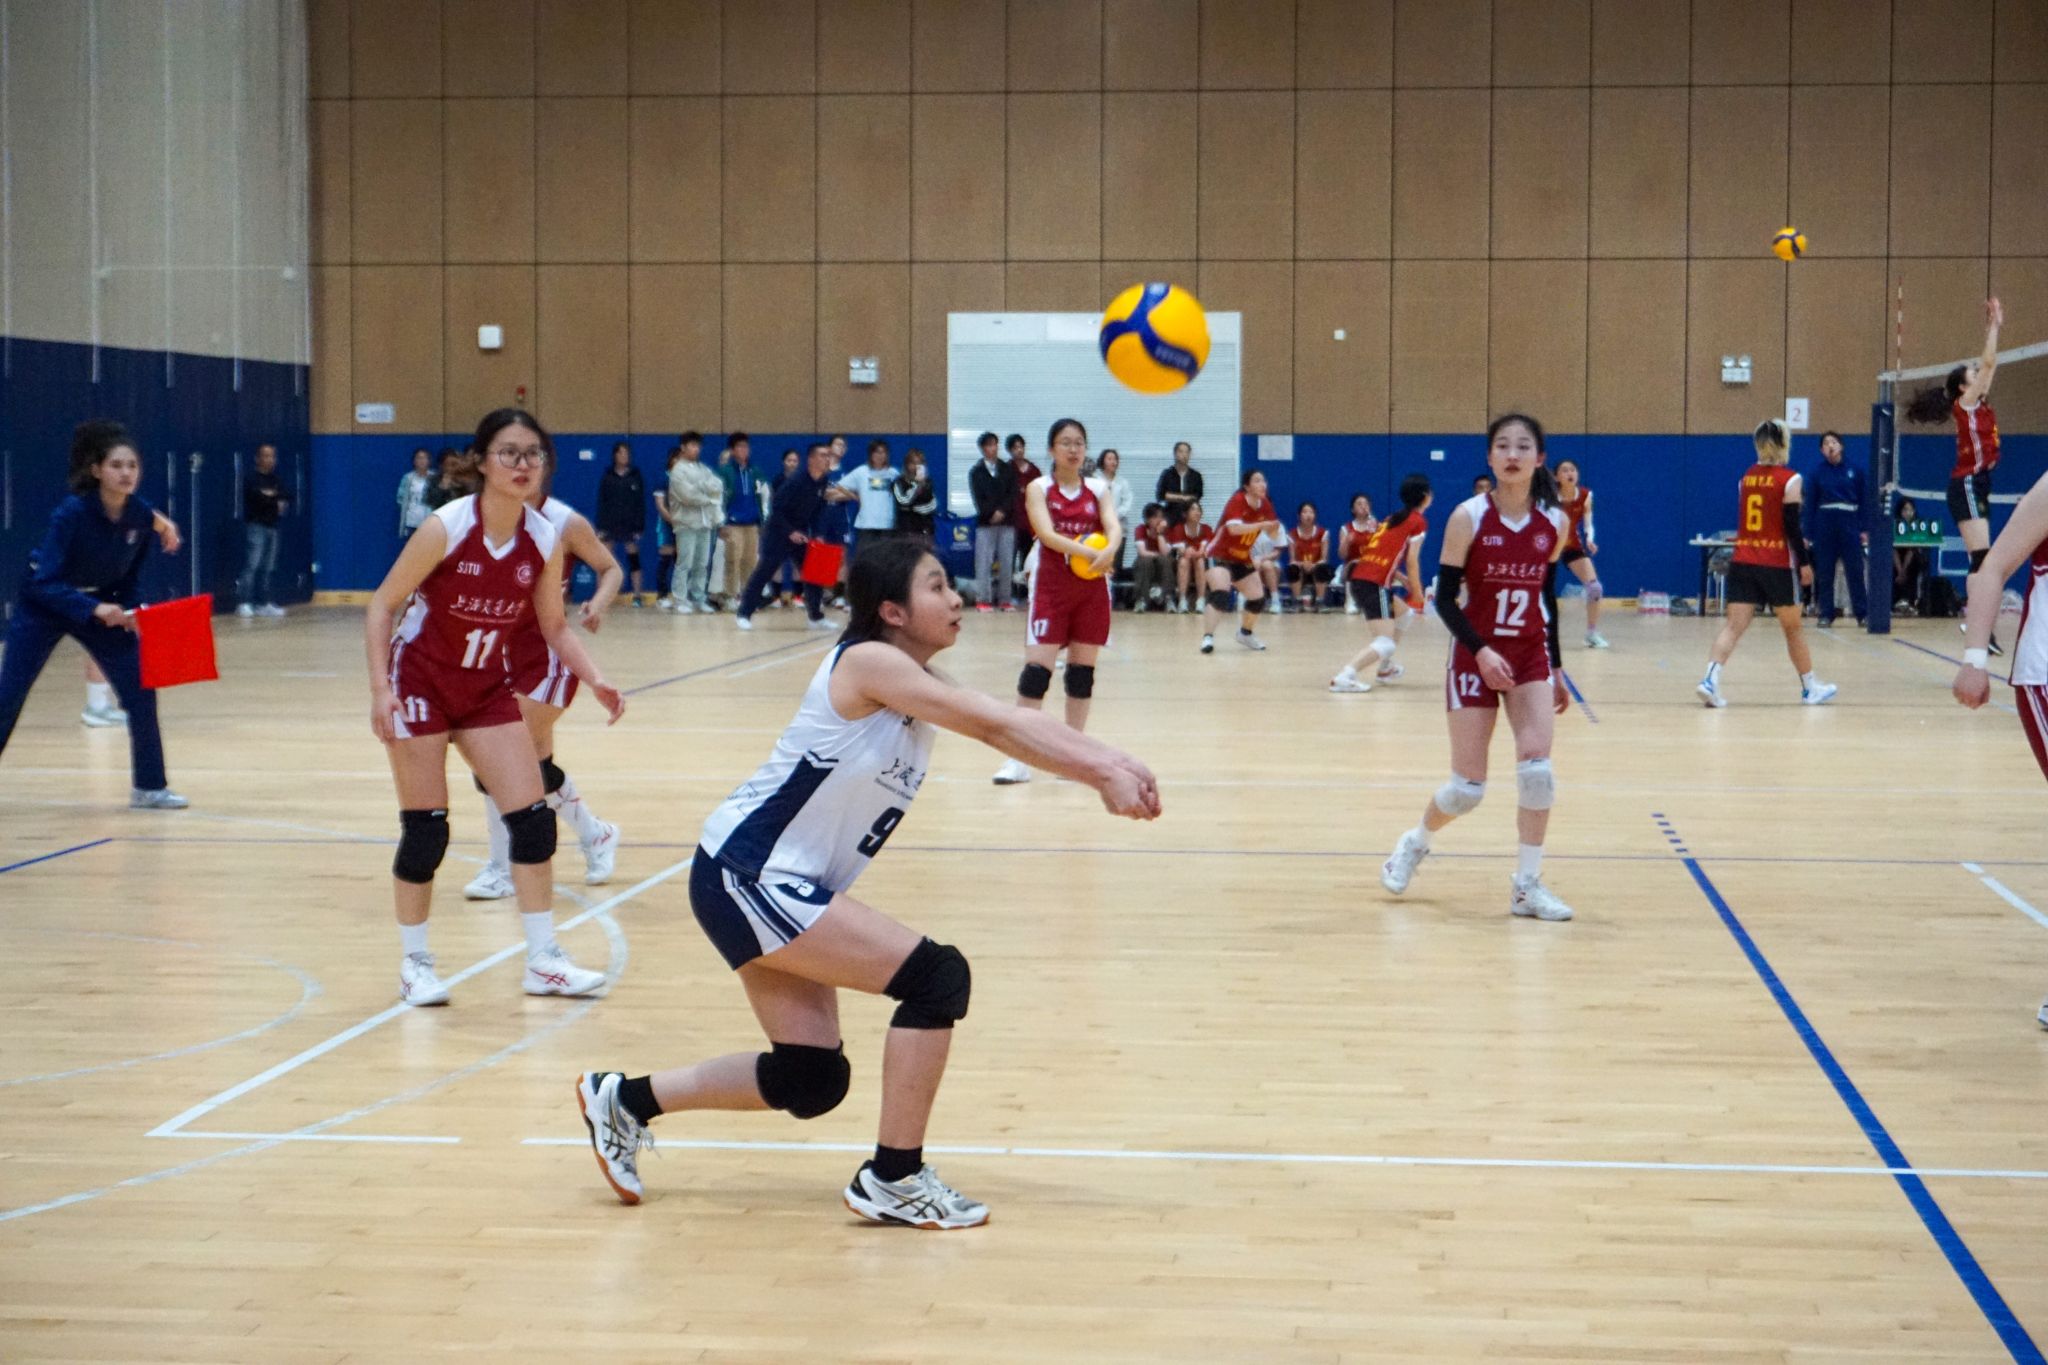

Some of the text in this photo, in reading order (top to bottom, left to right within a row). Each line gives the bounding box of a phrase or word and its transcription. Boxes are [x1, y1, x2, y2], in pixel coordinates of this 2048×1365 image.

[1792, 406, 1802, 423] 2
[1746, 494, 1763, 532] 6
[1898, 521, 1938, 535] 0 1 0 0
[457, 561, 481, 576] SJTU
[1495, 588, 1529, 627] 12
[1033, 618, 1049, 637] 17
[461, 628, 499, 669] 11
[1458, 672, 1481, 697] 12
[405, 696, 429, 722] 11
[857, 806, 905, 858] 9
